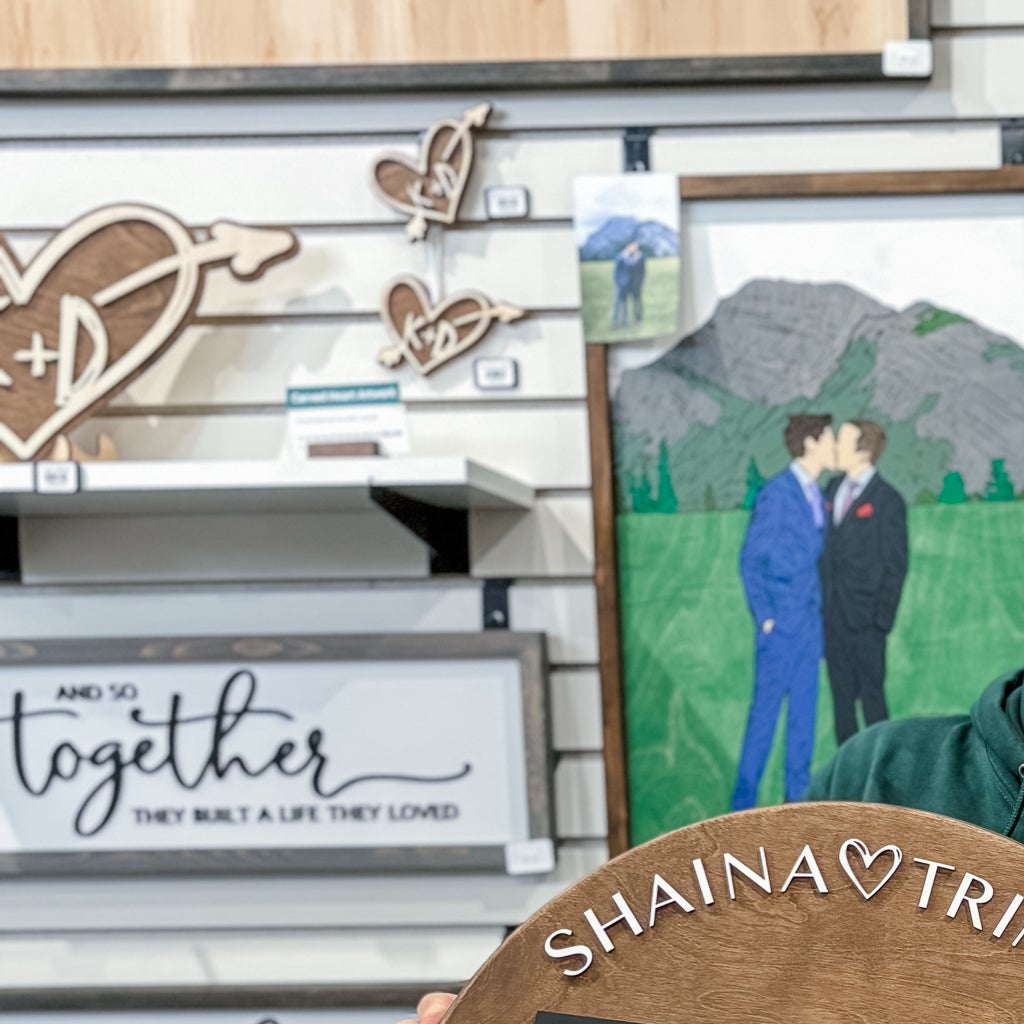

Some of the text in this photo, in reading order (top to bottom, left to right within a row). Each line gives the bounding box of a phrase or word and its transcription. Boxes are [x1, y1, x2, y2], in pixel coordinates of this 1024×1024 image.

[56, 683, 139, 701] AND SO
[0, 669, 472, 837] together
[133, 804, 460, 824] THEY BUILT A LIFE THEY LOVED
[543, 844, 829, 977] SHAINA
